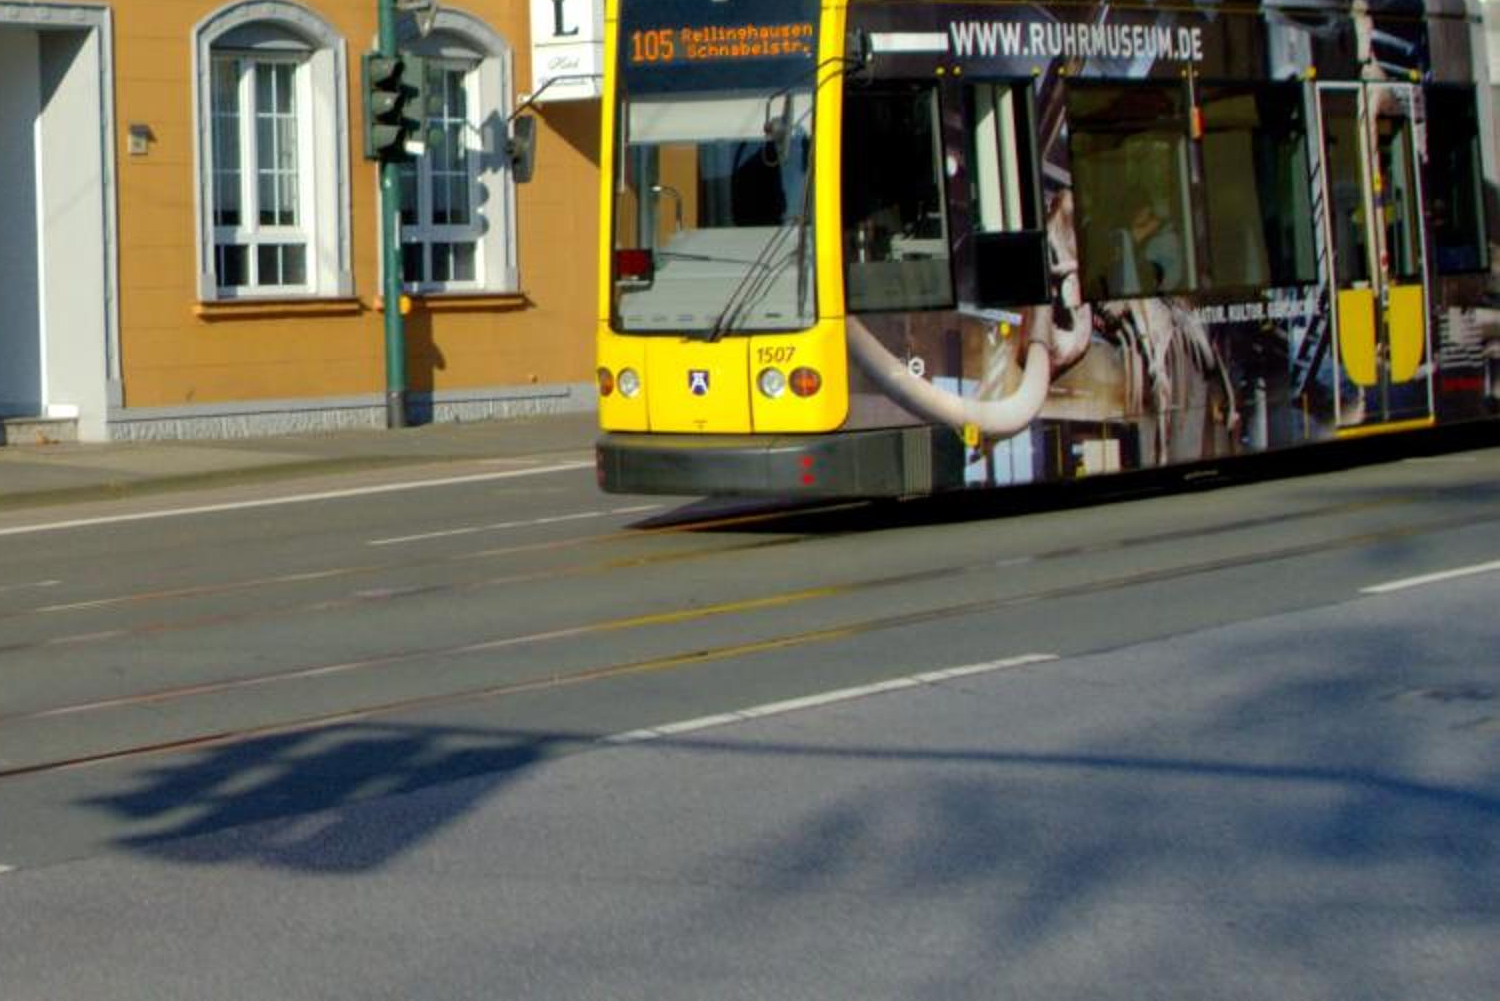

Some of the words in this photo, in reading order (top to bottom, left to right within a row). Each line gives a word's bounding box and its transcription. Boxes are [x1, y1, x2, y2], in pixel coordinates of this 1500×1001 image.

[631, 28, 675, 63] 105
[950, 21, 1203, 61] WWW.RUHRMUSEUM.DE
[756, 346, 797, 364] 1507
